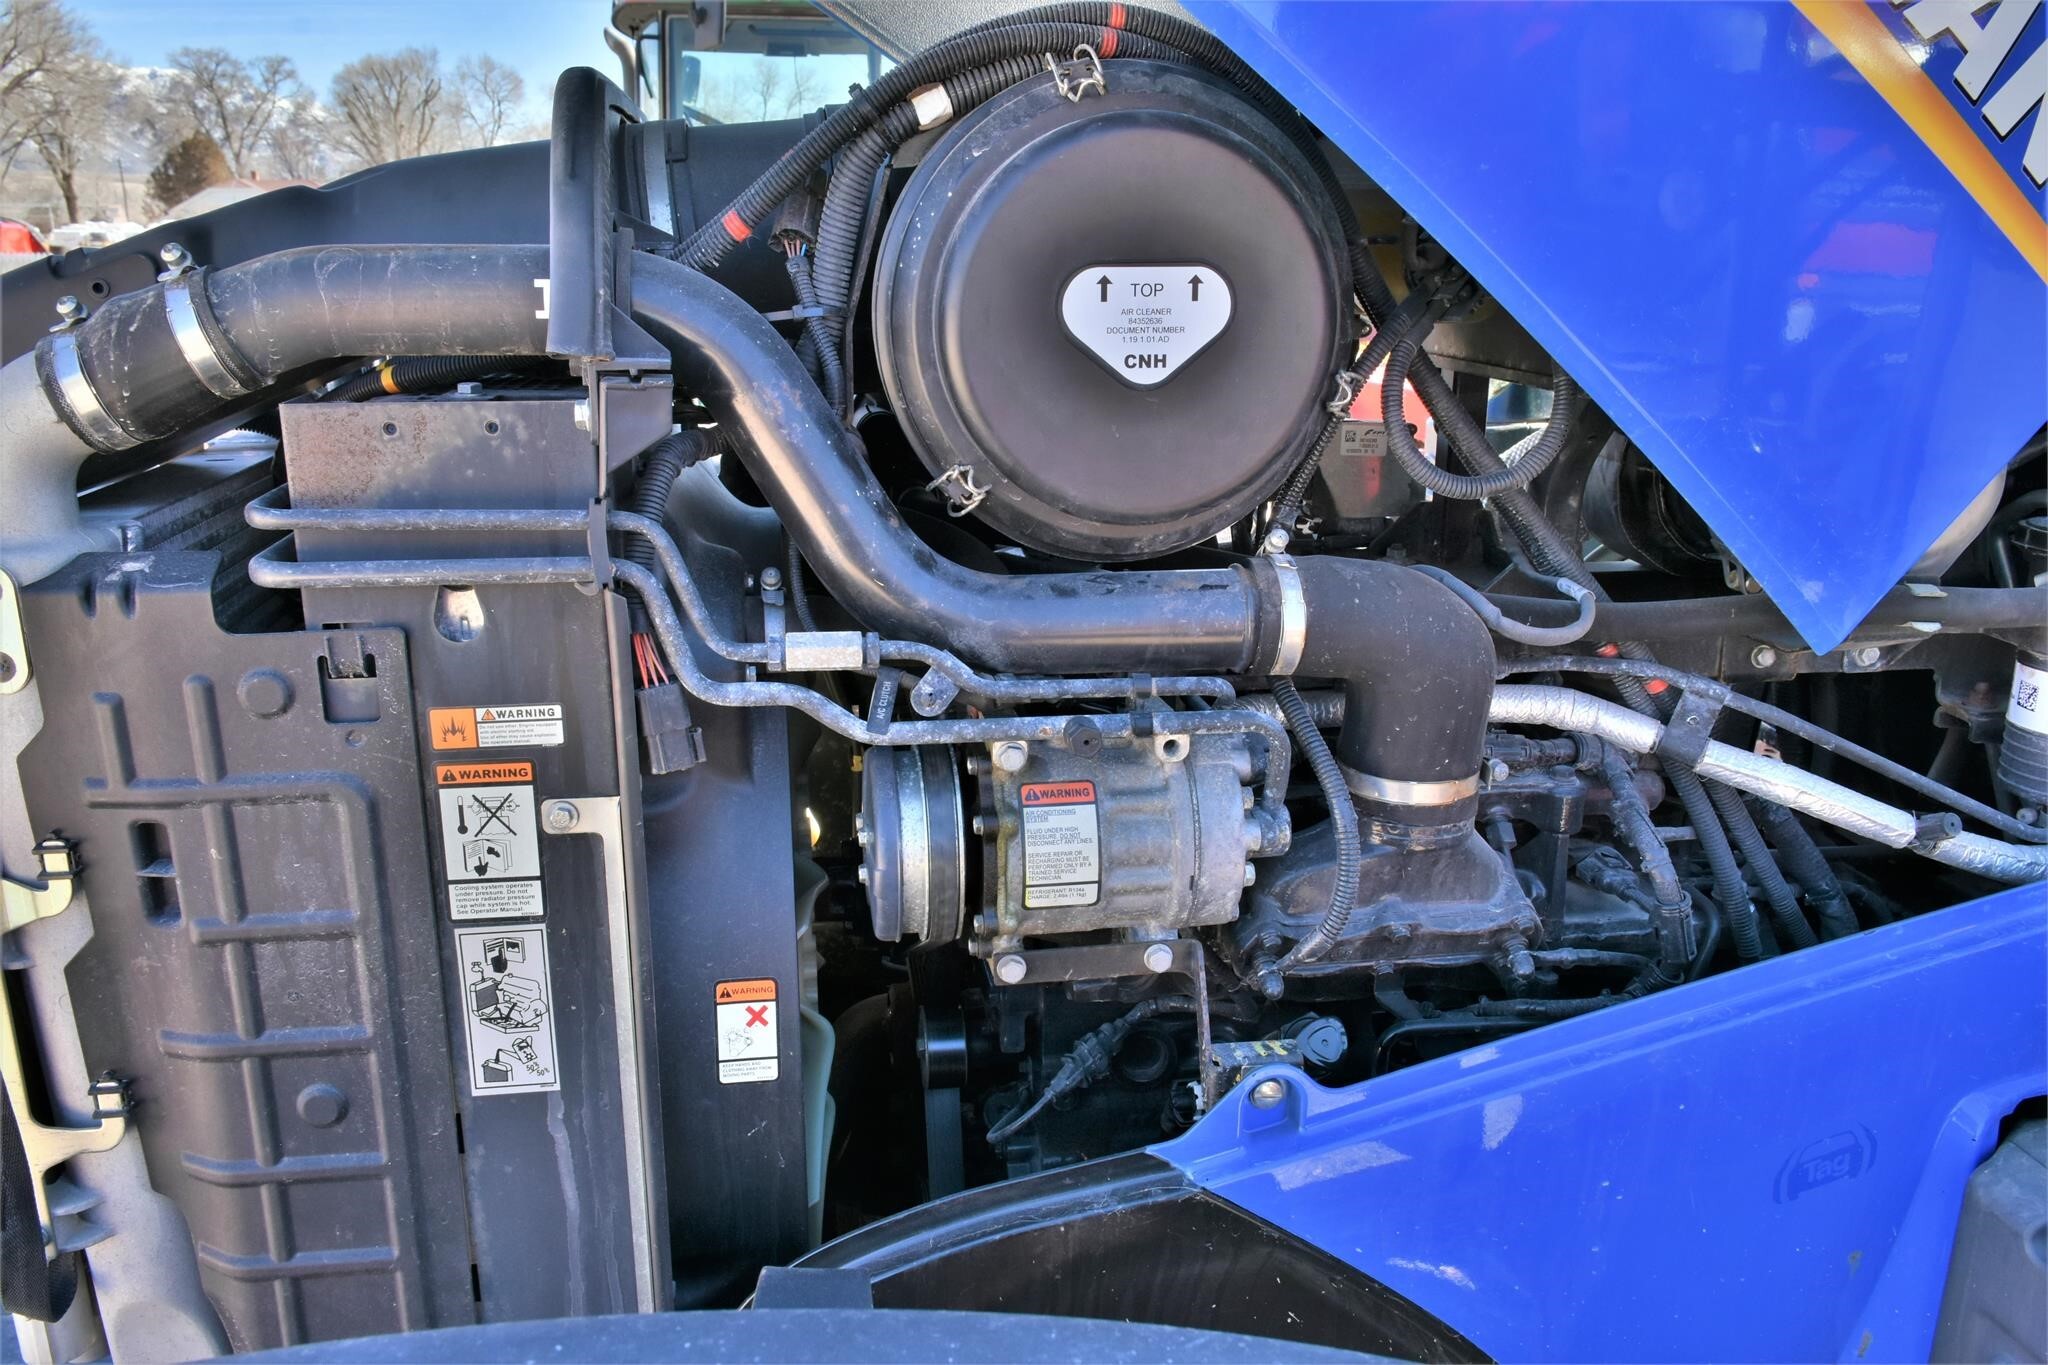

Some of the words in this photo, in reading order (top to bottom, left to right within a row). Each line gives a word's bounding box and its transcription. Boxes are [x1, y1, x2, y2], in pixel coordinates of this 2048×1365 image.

[1130, 283, 1164, 297] TOP
[1124, 354, 1167, 368] CNH
[879, 681, 892, 706] CLUTCH
[496, 708, 556, 719] WARNING
[876, 707, 886, 719] A/C
[458, 768, 529, 780] WARNING
[1040, 788, 1090, 799] WARNING
[731, 986, 773, 995] WARNING
[1803, 1153, 1851, 1183] Tag
